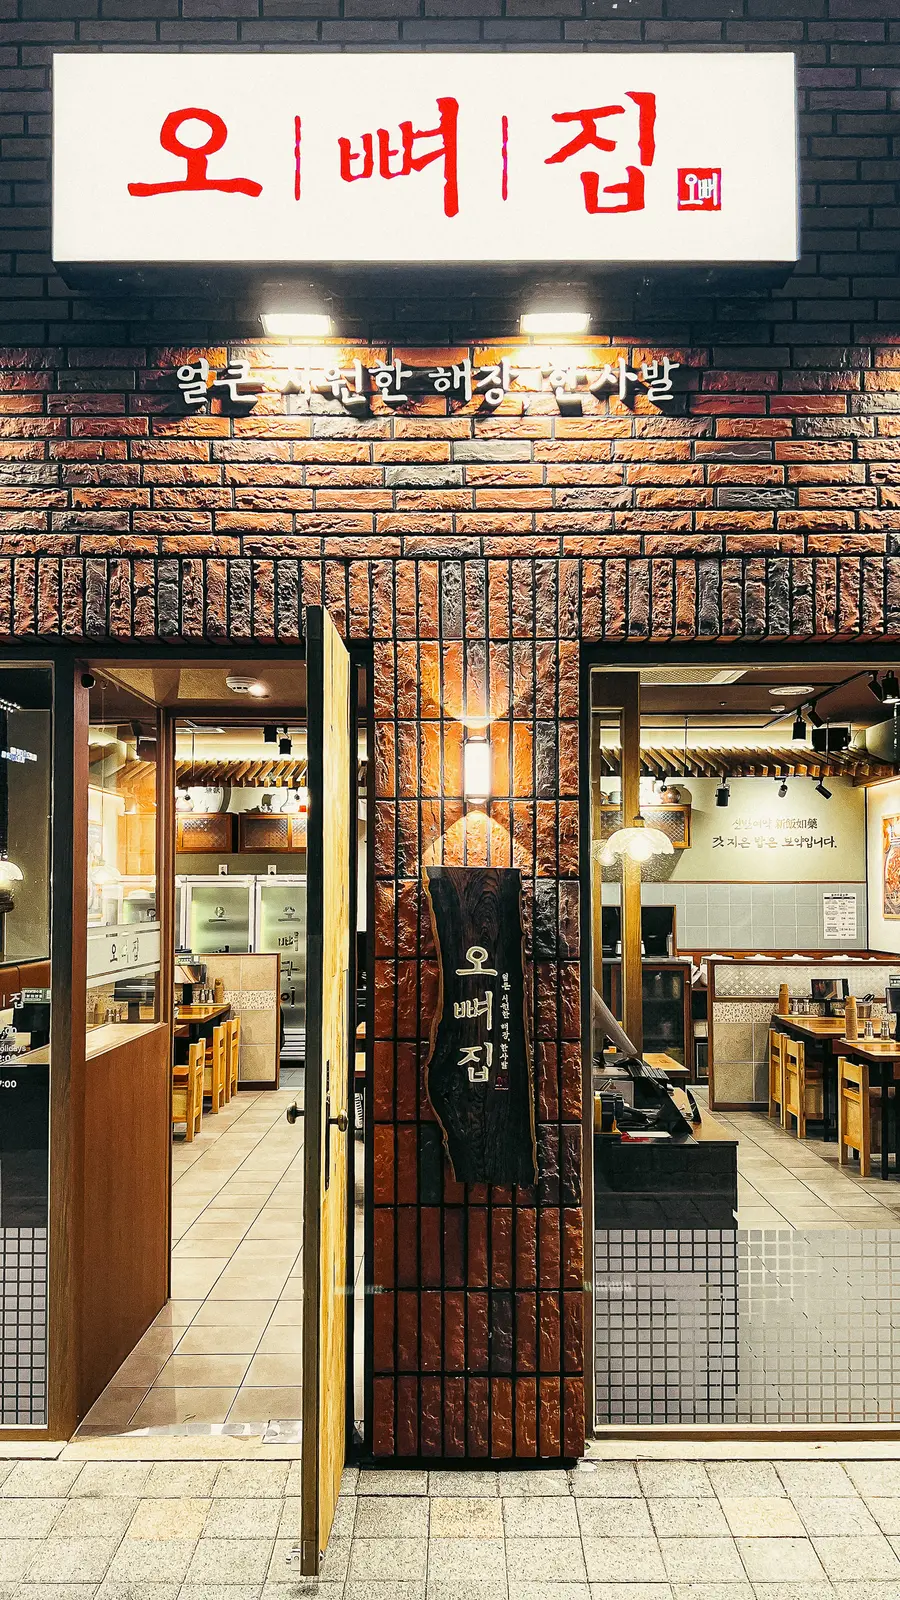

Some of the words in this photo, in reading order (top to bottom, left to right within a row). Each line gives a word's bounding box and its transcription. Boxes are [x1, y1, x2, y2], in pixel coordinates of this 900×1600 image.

[176, 357, 265, 404] 얼큰
[277, 357, 412, 402] 시원한
[727, 835, 751, 849] 지은
[754, 835, 778, 849] 밥은
[781, 835, 838, 849] 보약입니다.
